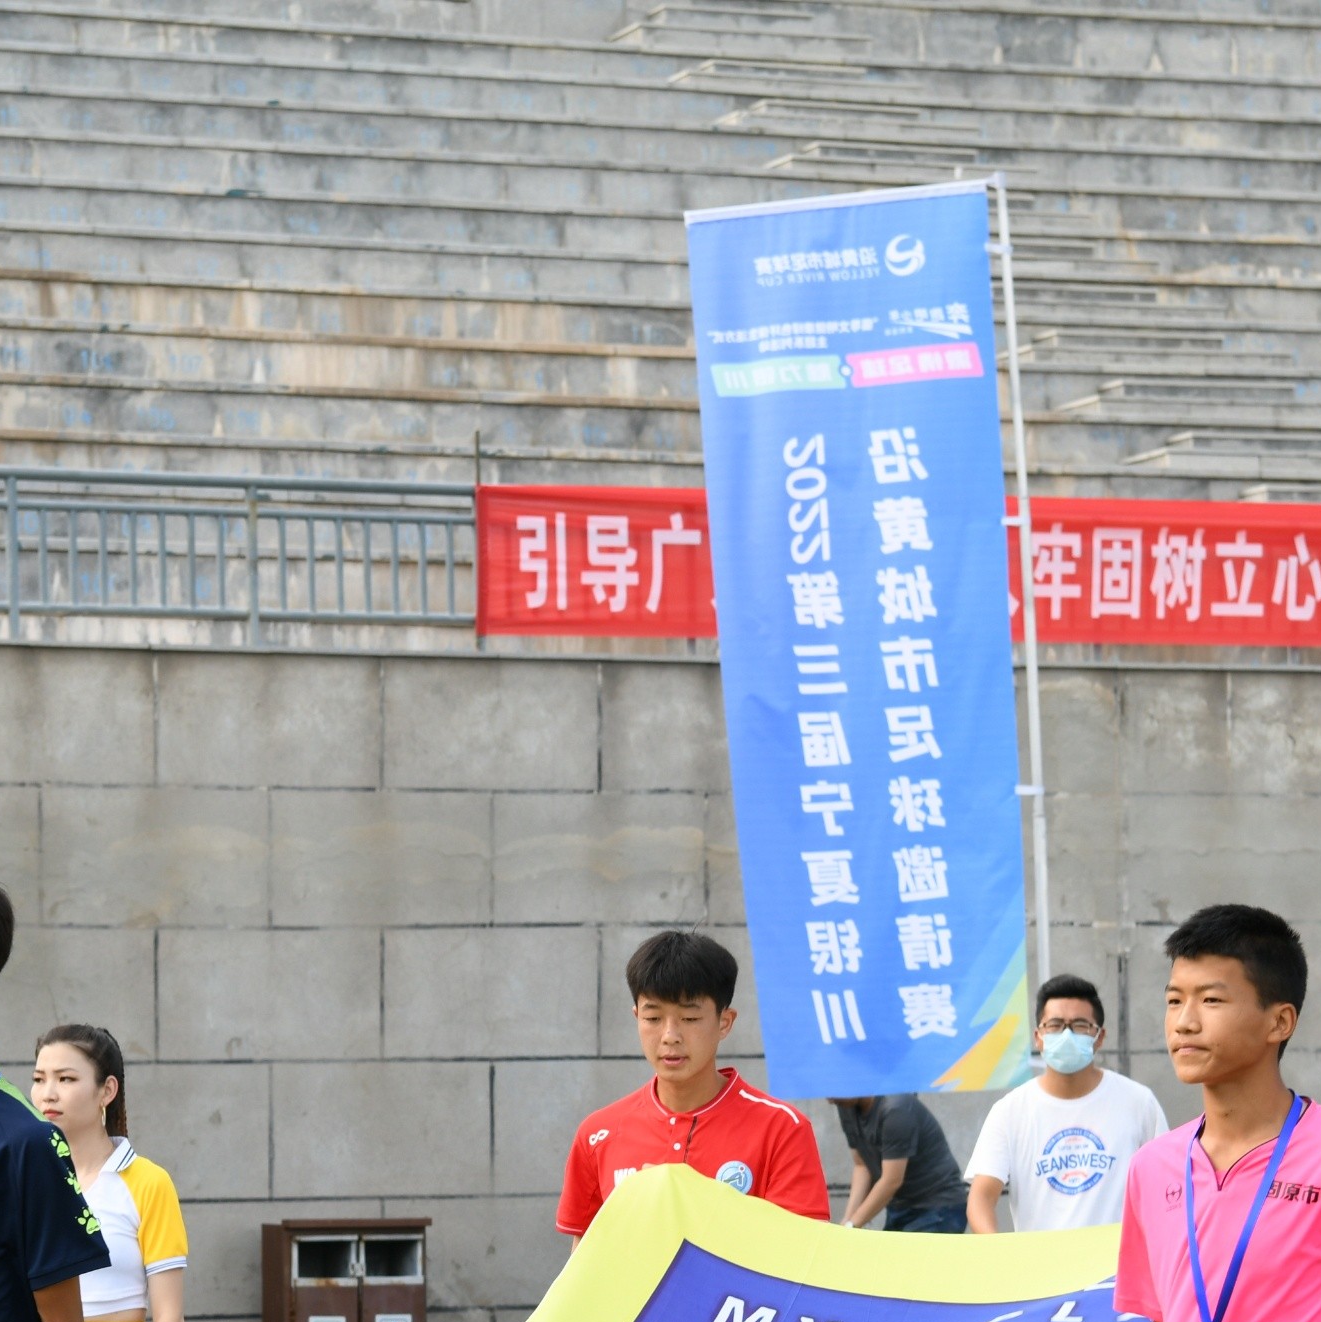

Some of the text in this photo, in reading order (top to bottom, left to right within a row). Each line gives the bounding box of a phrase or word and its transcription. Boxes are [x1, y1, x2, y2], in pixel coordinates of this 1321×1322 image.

[516, 512, 718, 614] 引导广
[1035, 1153, 1116, 1177] JEANSWEST
